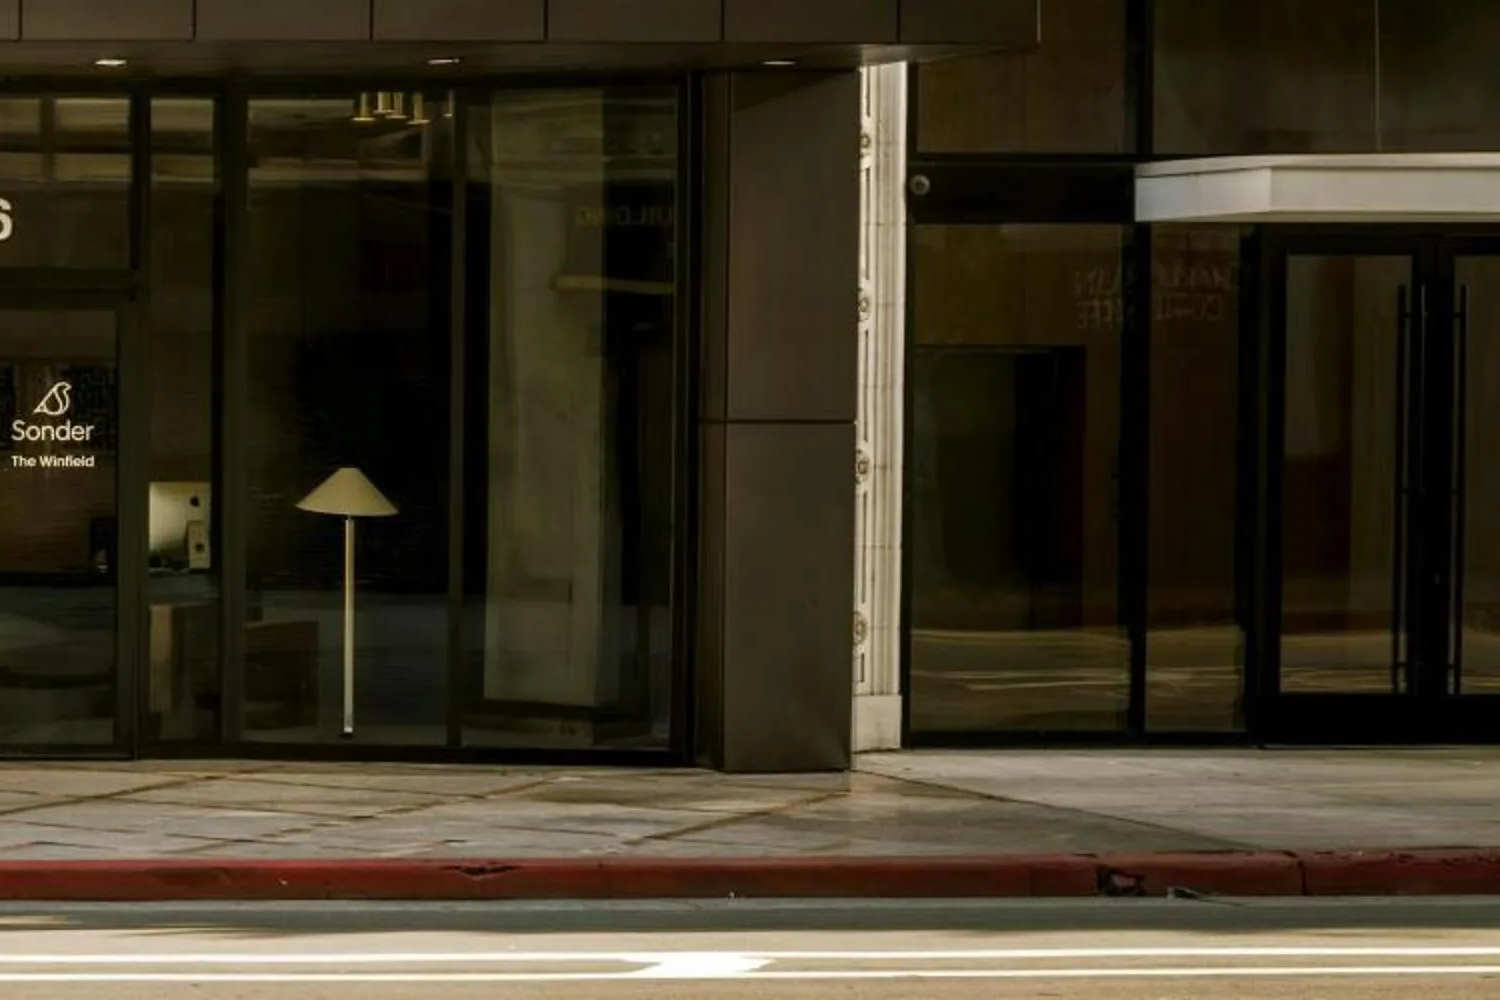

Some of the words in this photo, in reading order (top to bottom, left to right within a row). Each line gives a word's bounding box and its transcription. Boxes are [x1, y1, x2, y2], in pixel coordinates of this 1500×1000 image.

[11, 418, 95, 441] Sonder
[11, 455, 37, 468] The
[39, 455, 96, 468] Winfield
